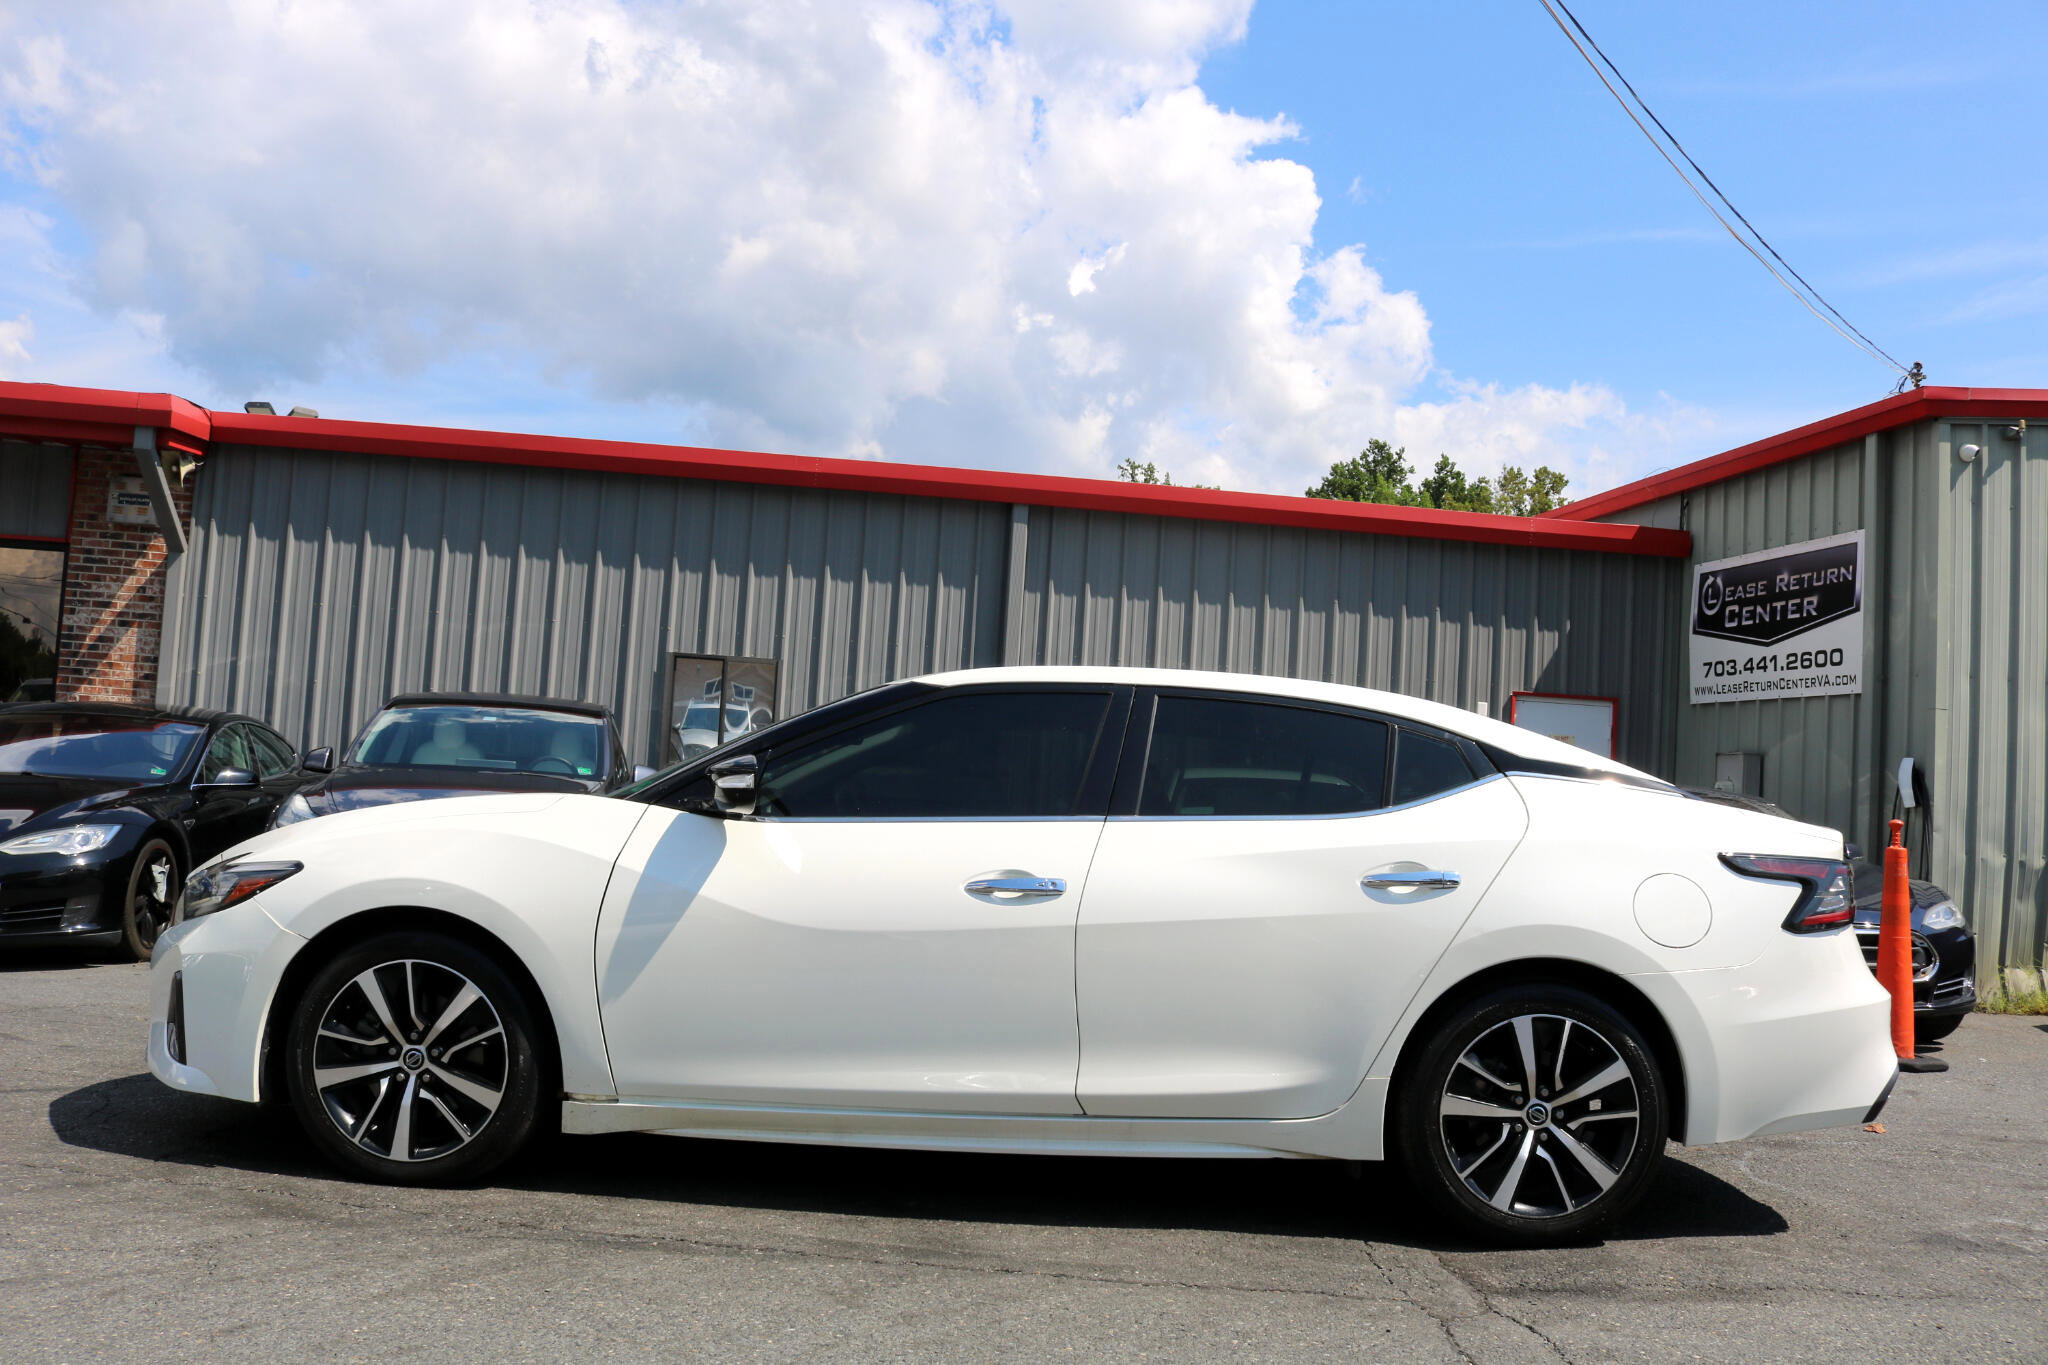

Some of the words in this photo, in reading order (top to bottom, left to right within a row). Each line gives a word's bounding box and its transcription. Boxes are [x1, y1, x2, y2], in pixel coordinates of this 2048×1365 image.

[1775, 565, 1853, 592] RETURN
[1724, 596, 1818, 628] CENTER
[1703, 648, 1843, 678] 703.441.2600
